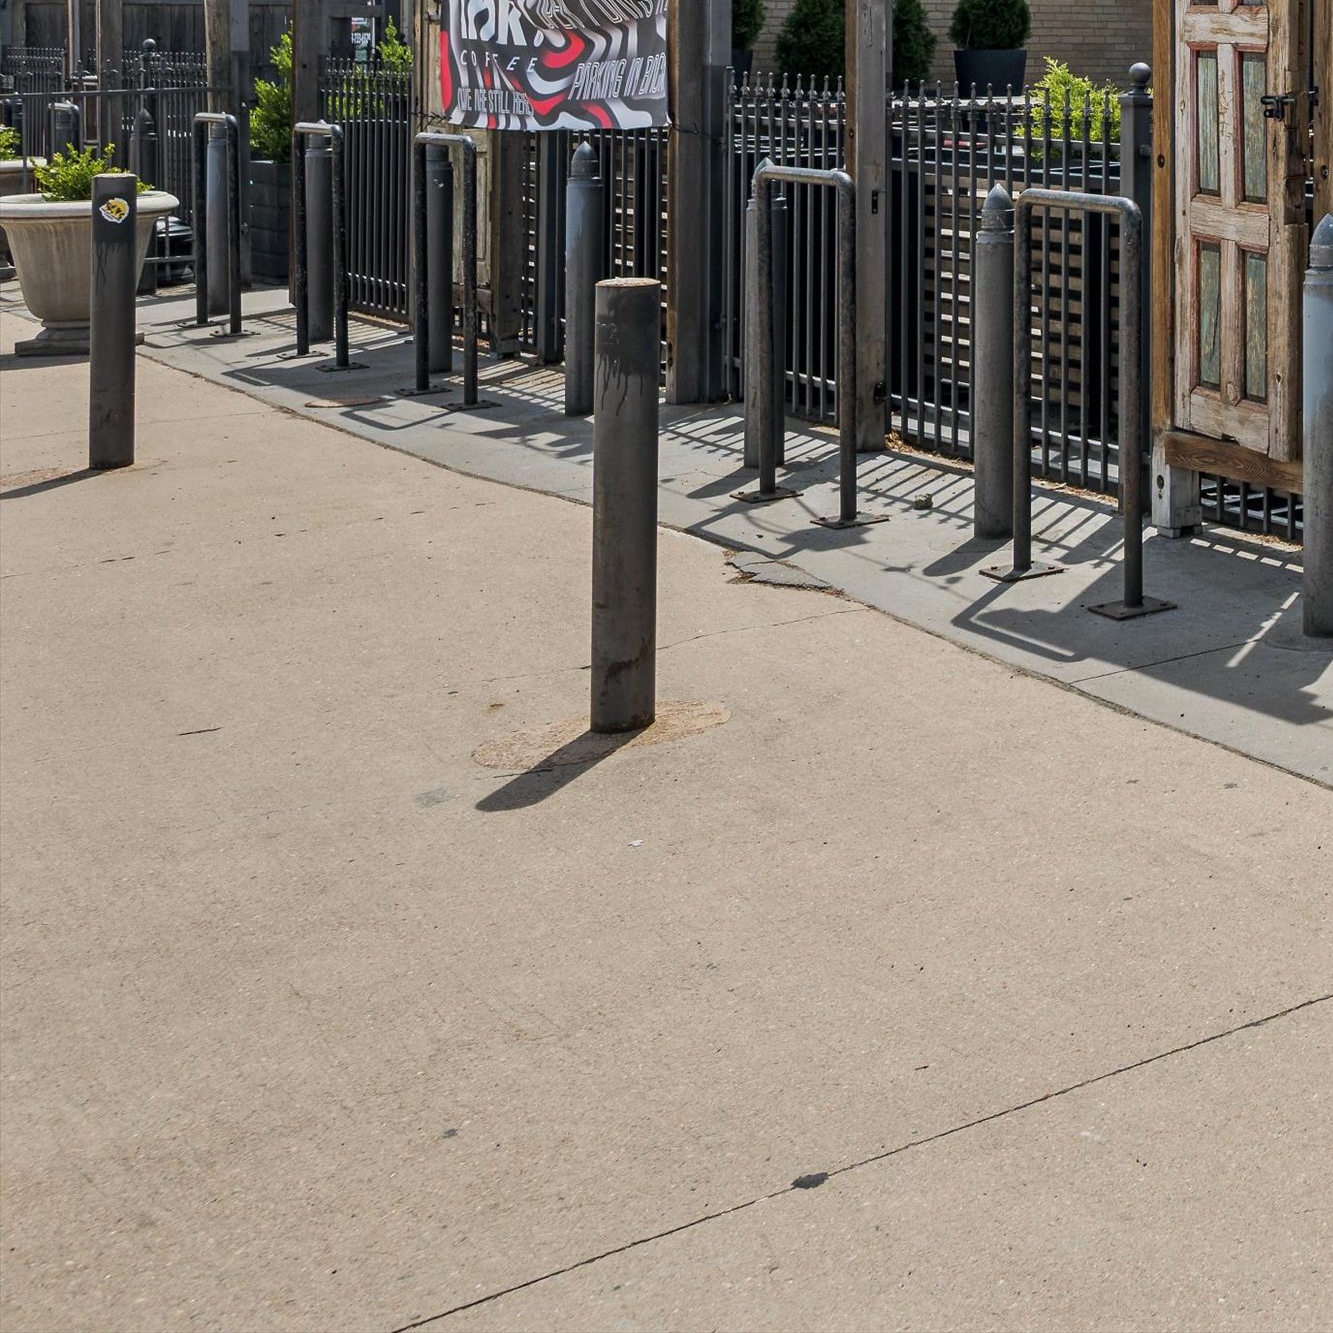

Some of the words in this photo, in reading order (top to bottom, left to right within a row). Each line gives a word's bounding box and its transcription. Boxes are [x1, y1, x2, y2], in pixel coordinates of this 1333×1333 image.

[568, 58, 627, 100] PARKING
[624, 57, 643, 97] IN
[488, 89, 510, 114] STILL
